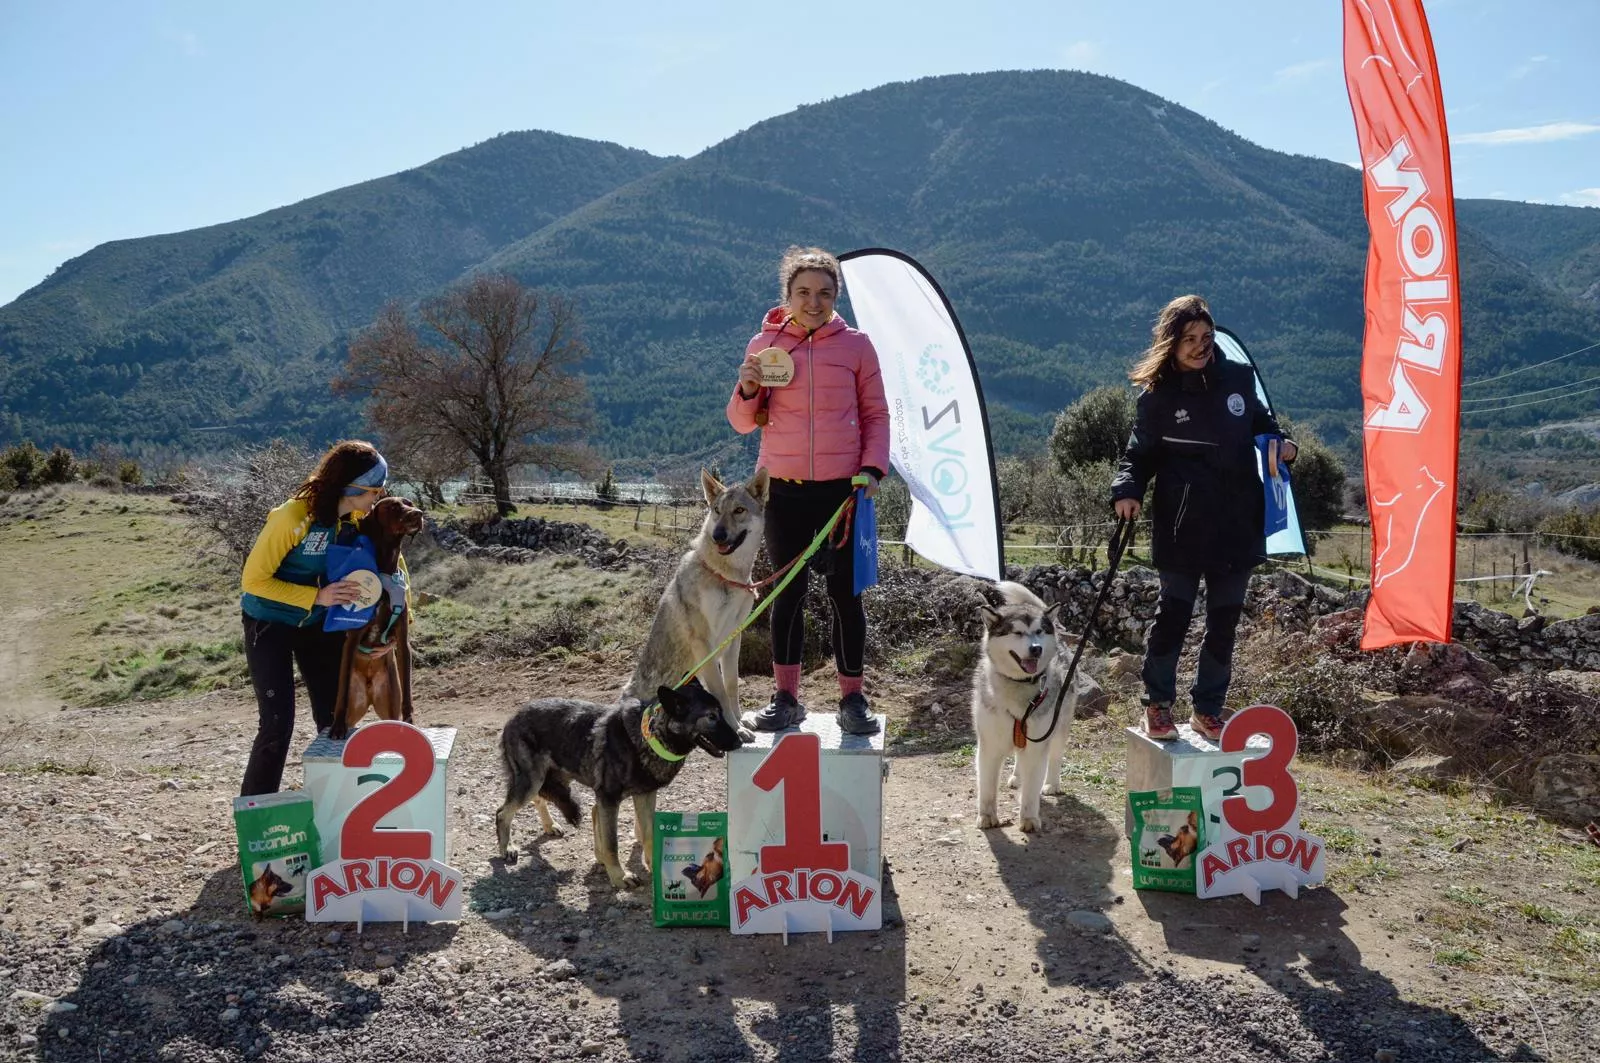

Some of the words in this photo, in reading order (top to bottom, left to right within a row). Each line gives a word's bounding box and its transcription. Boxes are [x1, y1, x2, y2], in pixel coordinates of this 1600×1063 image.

[340, 722, 435, 860] 2
[752, 734, 849, 874] 1
[1222, 706, 1298, 836] 3
[312, 857, 457, 915] ARION
[733, 868, 876, 928] ARION
[1201, 831, 1321, 893] ARION
